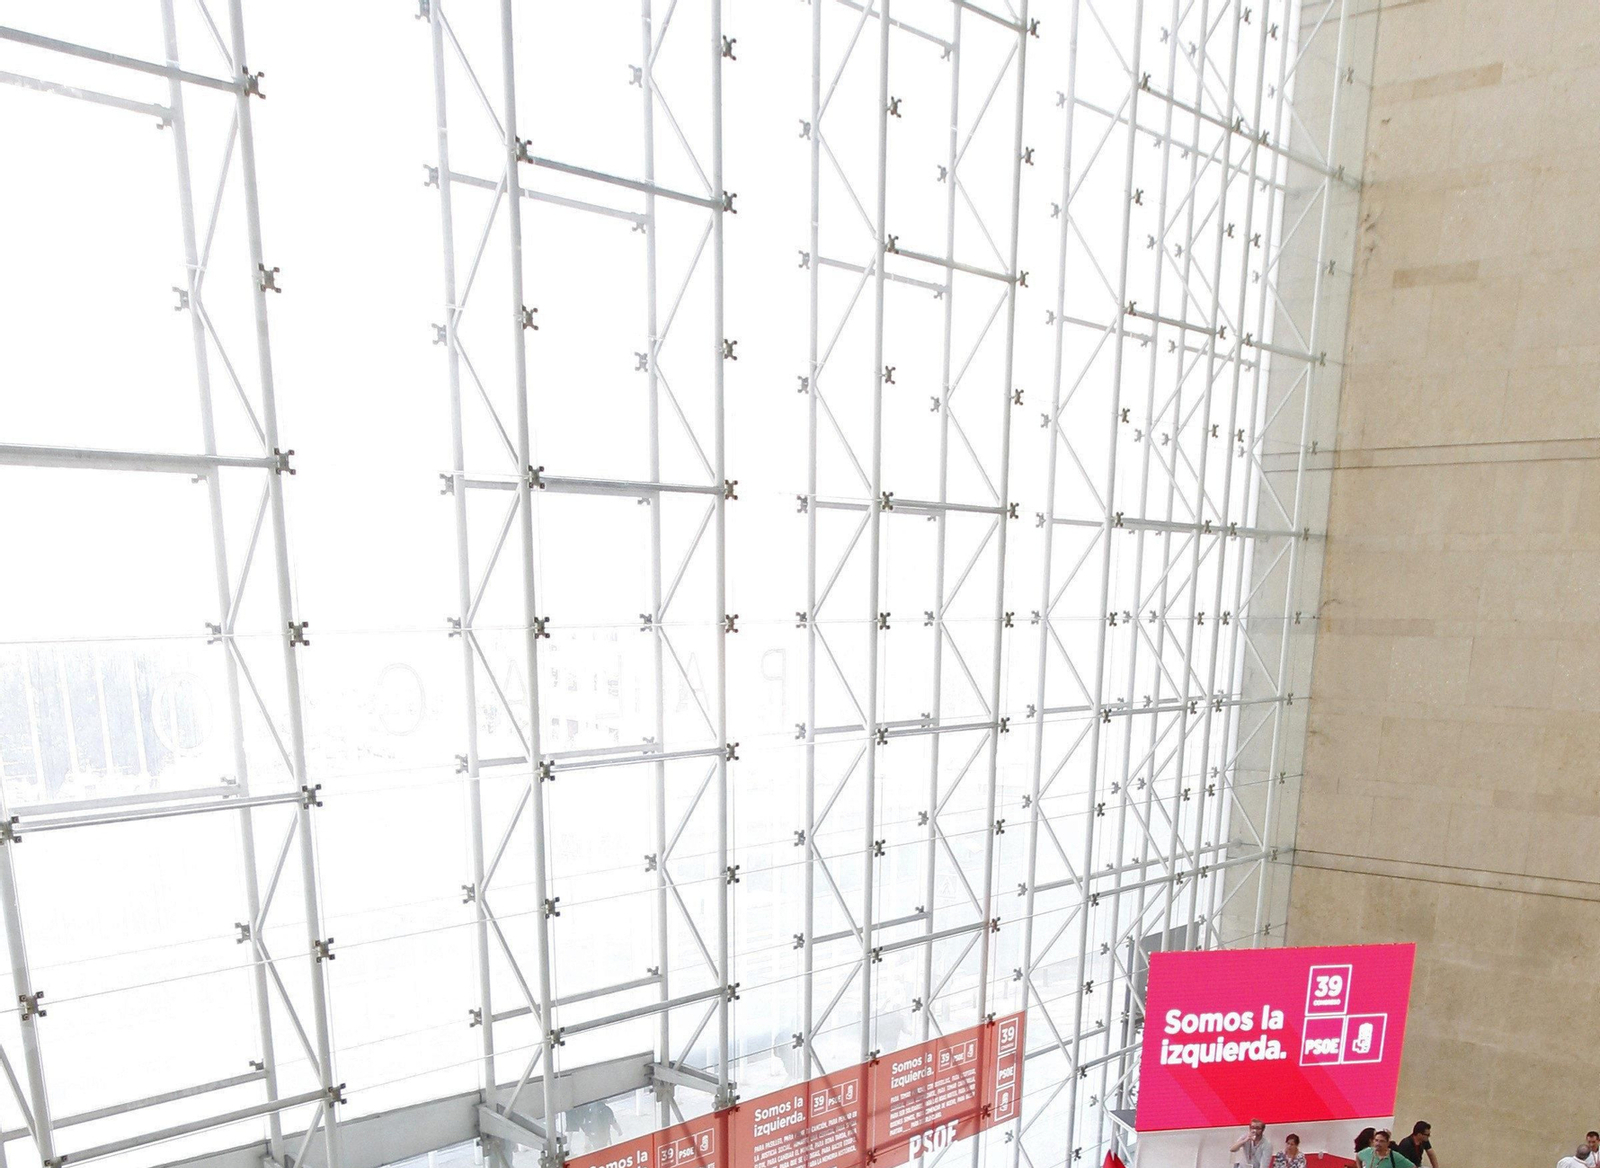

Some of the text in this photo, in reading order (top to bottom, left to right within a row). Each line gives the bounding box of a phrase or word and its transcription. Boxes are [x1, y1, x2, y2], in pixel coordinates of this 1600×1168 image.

[1314, 975, 1342, 997] 39
[1165, 1004, 1284, 1034] Somos la
[1001, 1026, 1014, 1043] 39
[1160, 1035, 1287, 1068] izquierda.
[1304, 1038, 1341, 1055] PSOE
[892, 1052, 933, 1074] Somos la
[941, 1052, 950, 1063] 39
[891, 1066, 935, 1089] izquierda.
[754, 1096, 803, 1122] Somos la
[814, 1096, 824, 1107] 39
[754, 1111, 806, 1137] izquierda.
[637, 1151, 648, 1165] la
[661, 1148, 674, 1161] 39
[679, 1147, 694, 1159] PSOE
